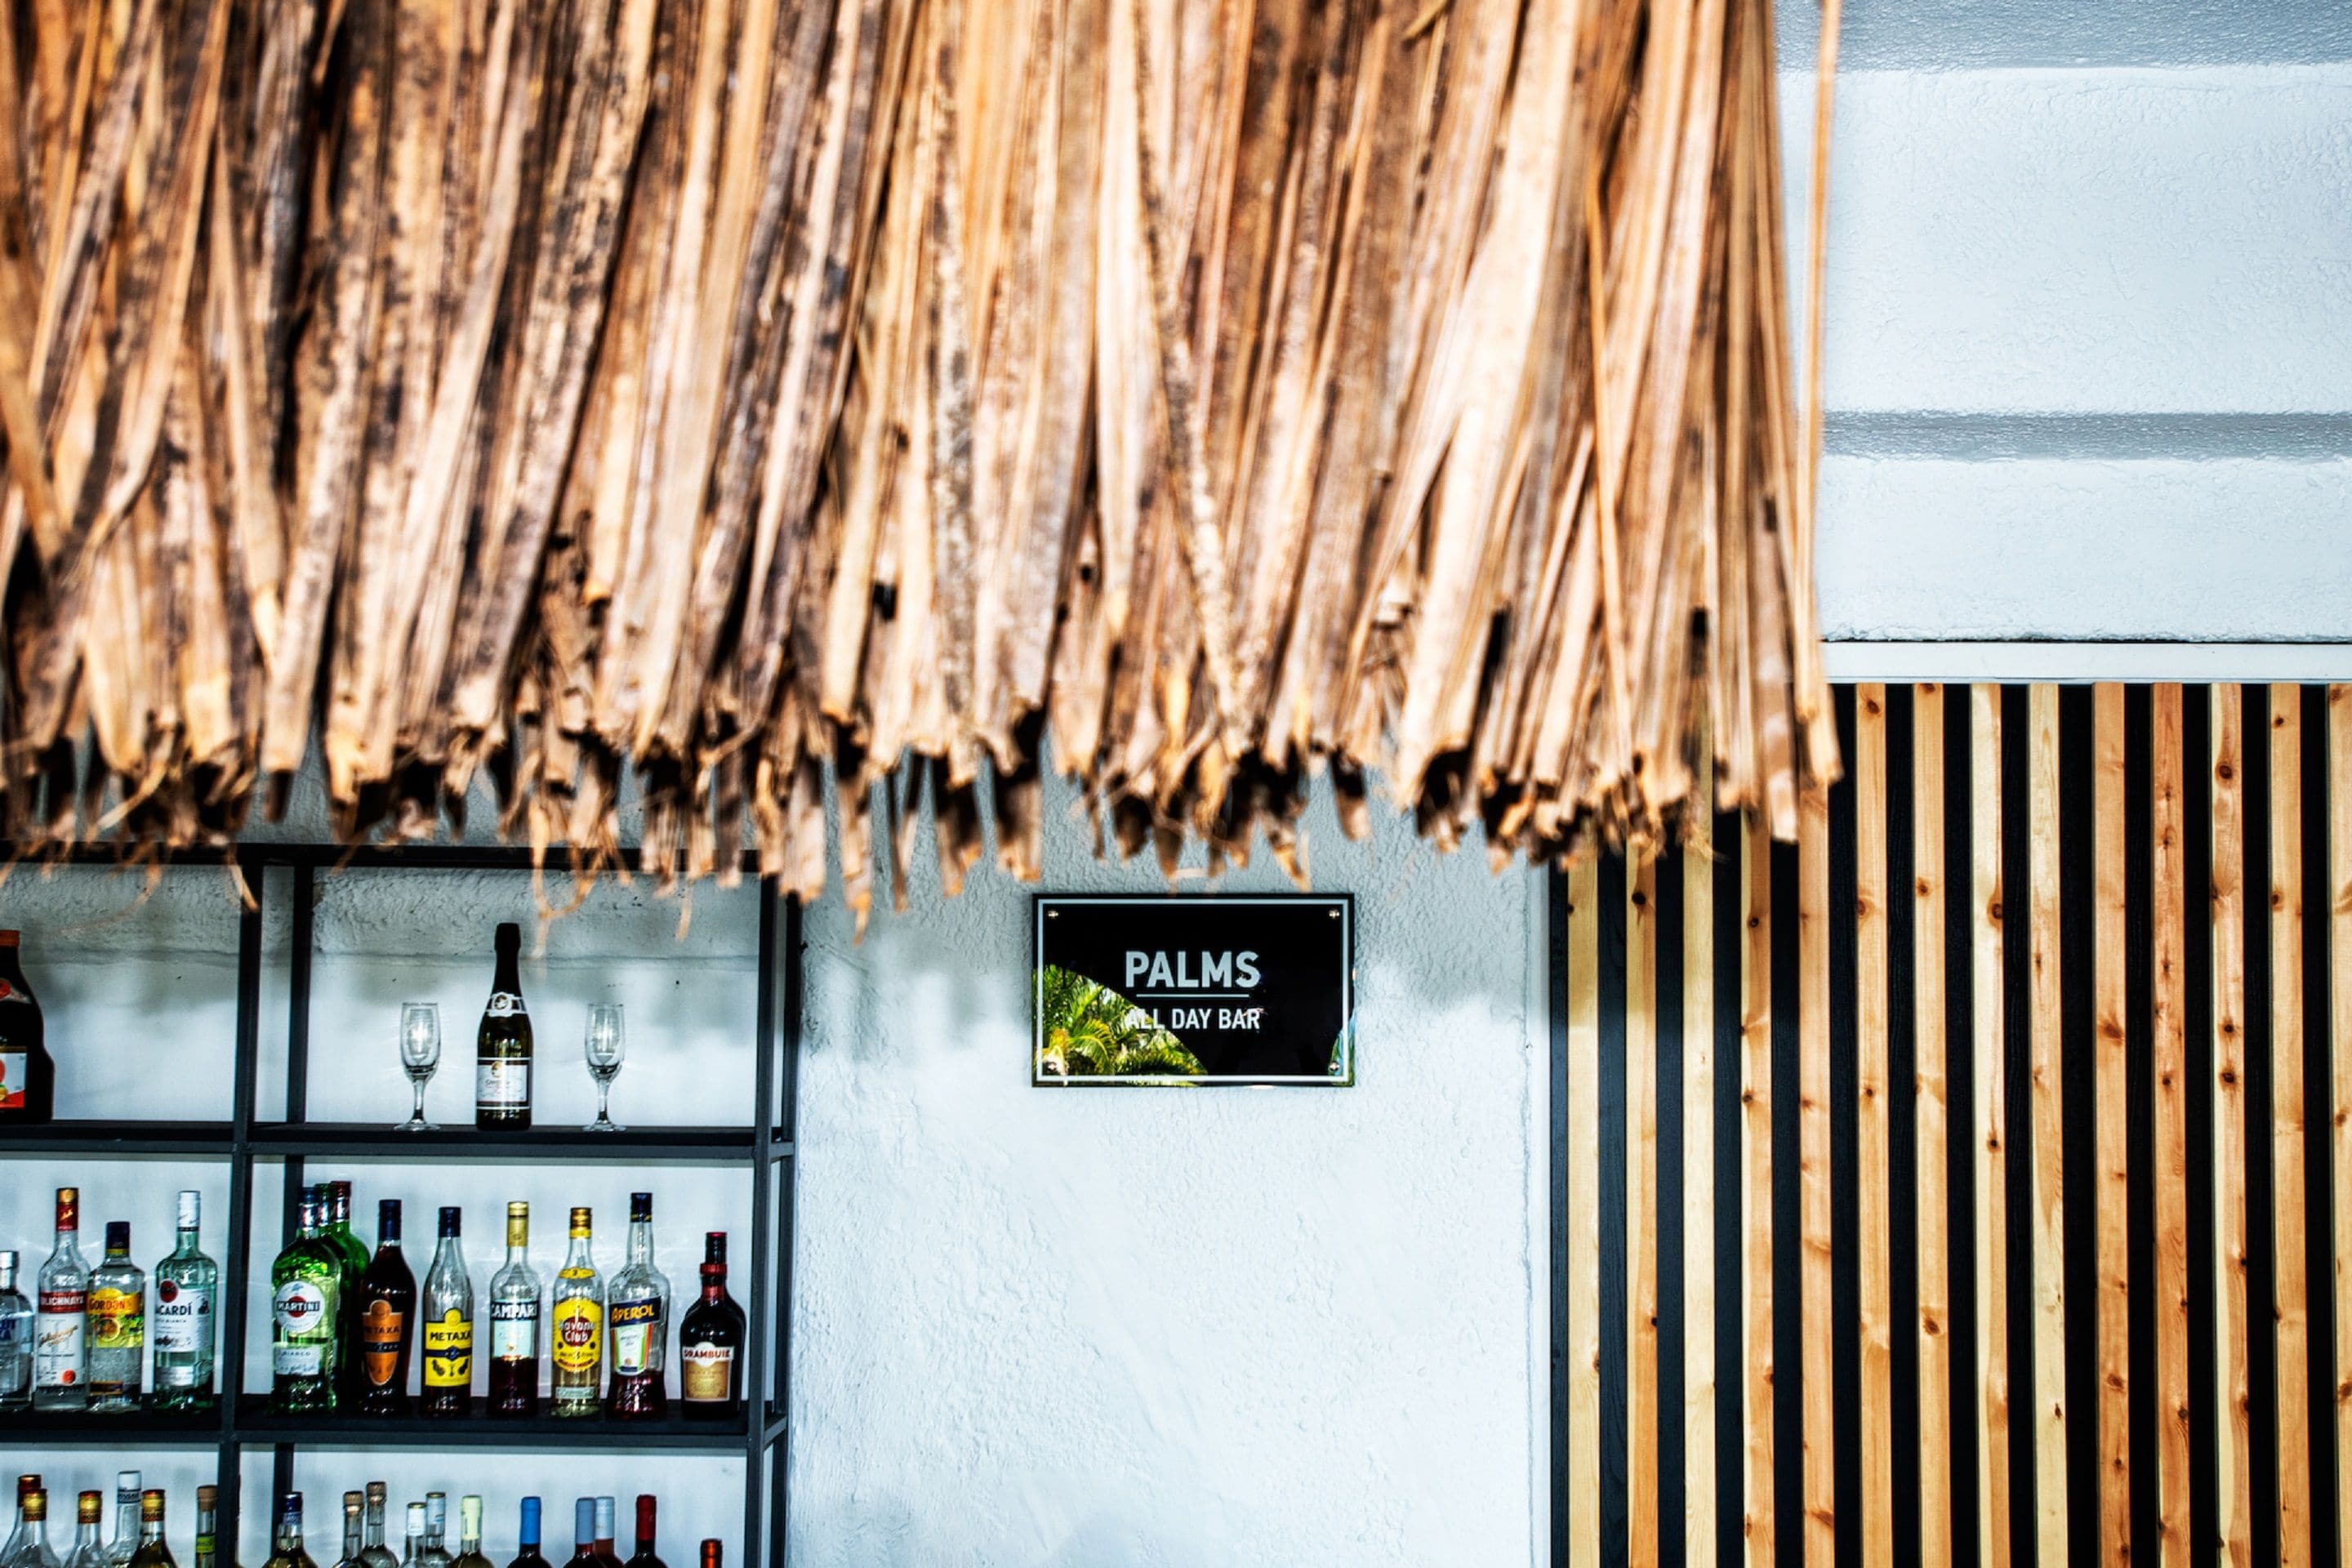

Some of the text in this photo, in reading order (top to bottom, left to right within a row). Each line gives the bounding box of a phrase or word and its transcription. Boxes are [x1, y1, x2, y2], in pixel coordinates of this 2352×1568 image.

[1125, 950, 1261, 988] PALMS
[1125, 1008, 1261, 1030] ALL DAY BAR
[278, 1301, 318, 1312] MARTINI
[611, 1304, 655, 1323] APEROL
[430, 1330, 471, 1341] METAXA
[564, 1330, 588, 1343] Club
[684, 1348, 730, 1358] DRAMBUIE
